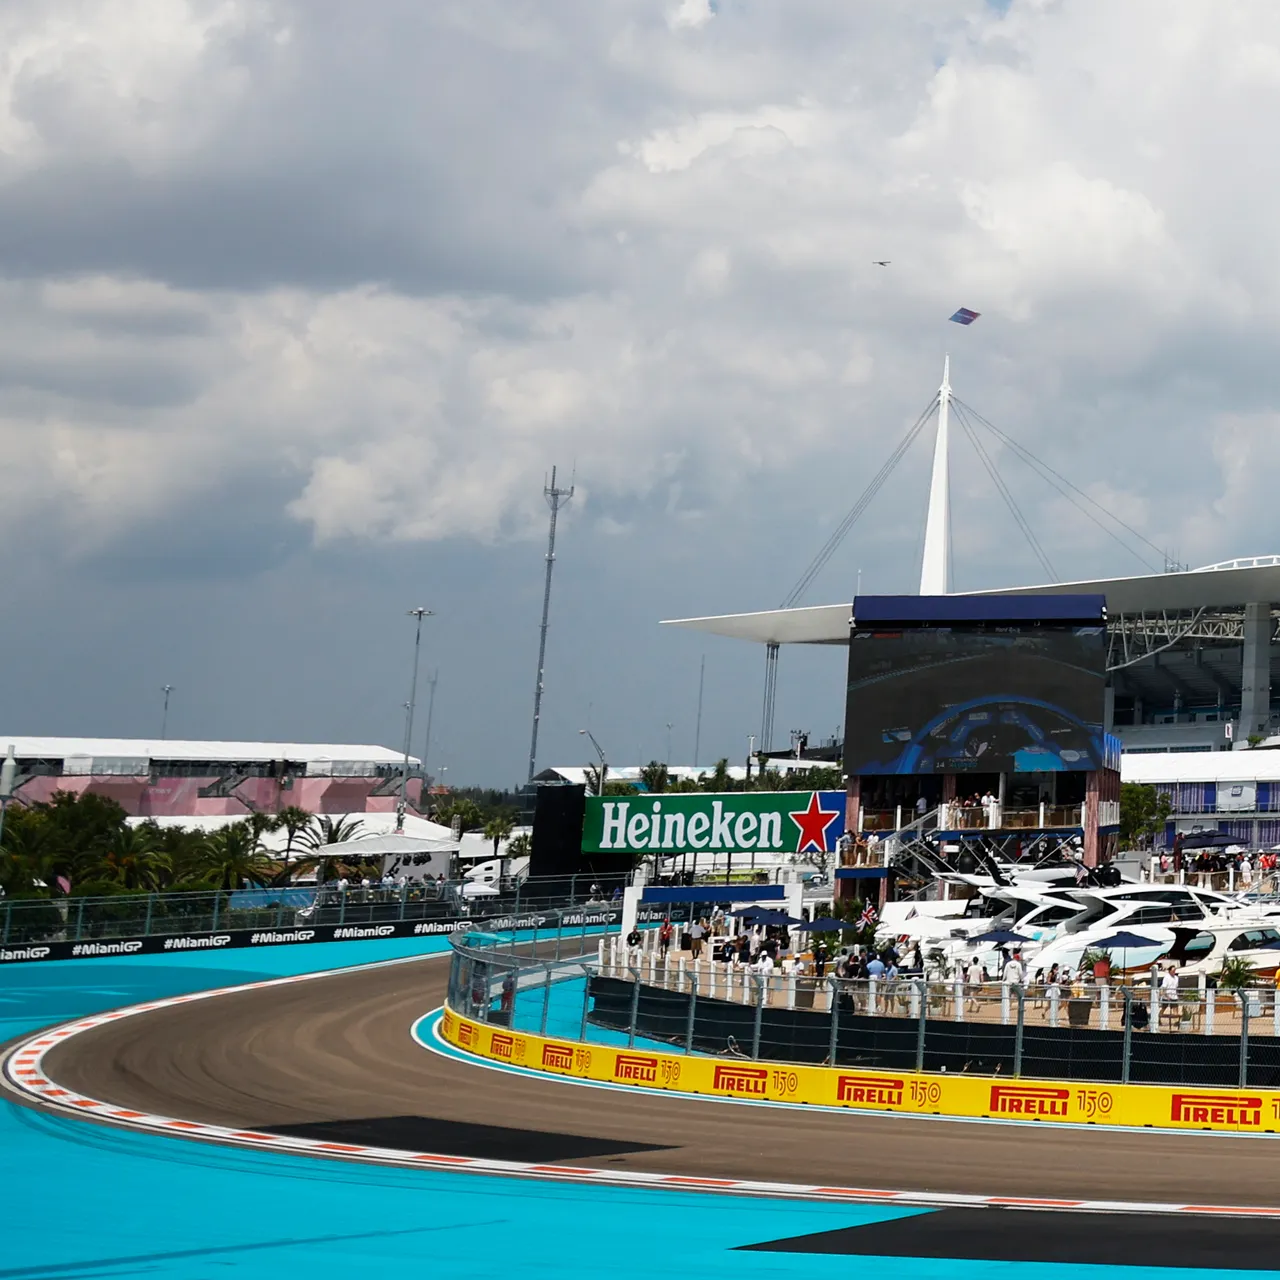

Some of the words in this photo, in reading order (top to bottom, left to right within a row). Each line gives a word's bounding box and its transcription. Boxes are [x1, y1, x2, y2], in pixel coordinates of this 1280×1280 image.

[599, 801, 783, 849] Heineken
[164, 936, 231, 950] #MiamiGP
[251, 930, 315, 944] #MiamiGP
[333, 925, 395, 939] #MiamiGP
[0, 946, 50, 961] iamiGP
[72, 941, 143, 957] #MiamiGP
[490, 1032, 514, 1058] PIRELLI
[542, 1043, 574, 1070] PIRELLI
[615, 1054, 659, 1082] PIRELLI
[661, 1059, 681, 1085] 150
[712, 1065, 769, 1094] PIRELLI
[772, 1070, 799, 1097] 150
[837, 1076, 905, 1106] PIRELLI
[909, 1080, 942, 1108] 150
[989, 1085, 1070, 1116] PIRELLI
[1076, 1089, 1114, 1118] 150
[1171, 1094, 1263, 1125] PIRELLI
